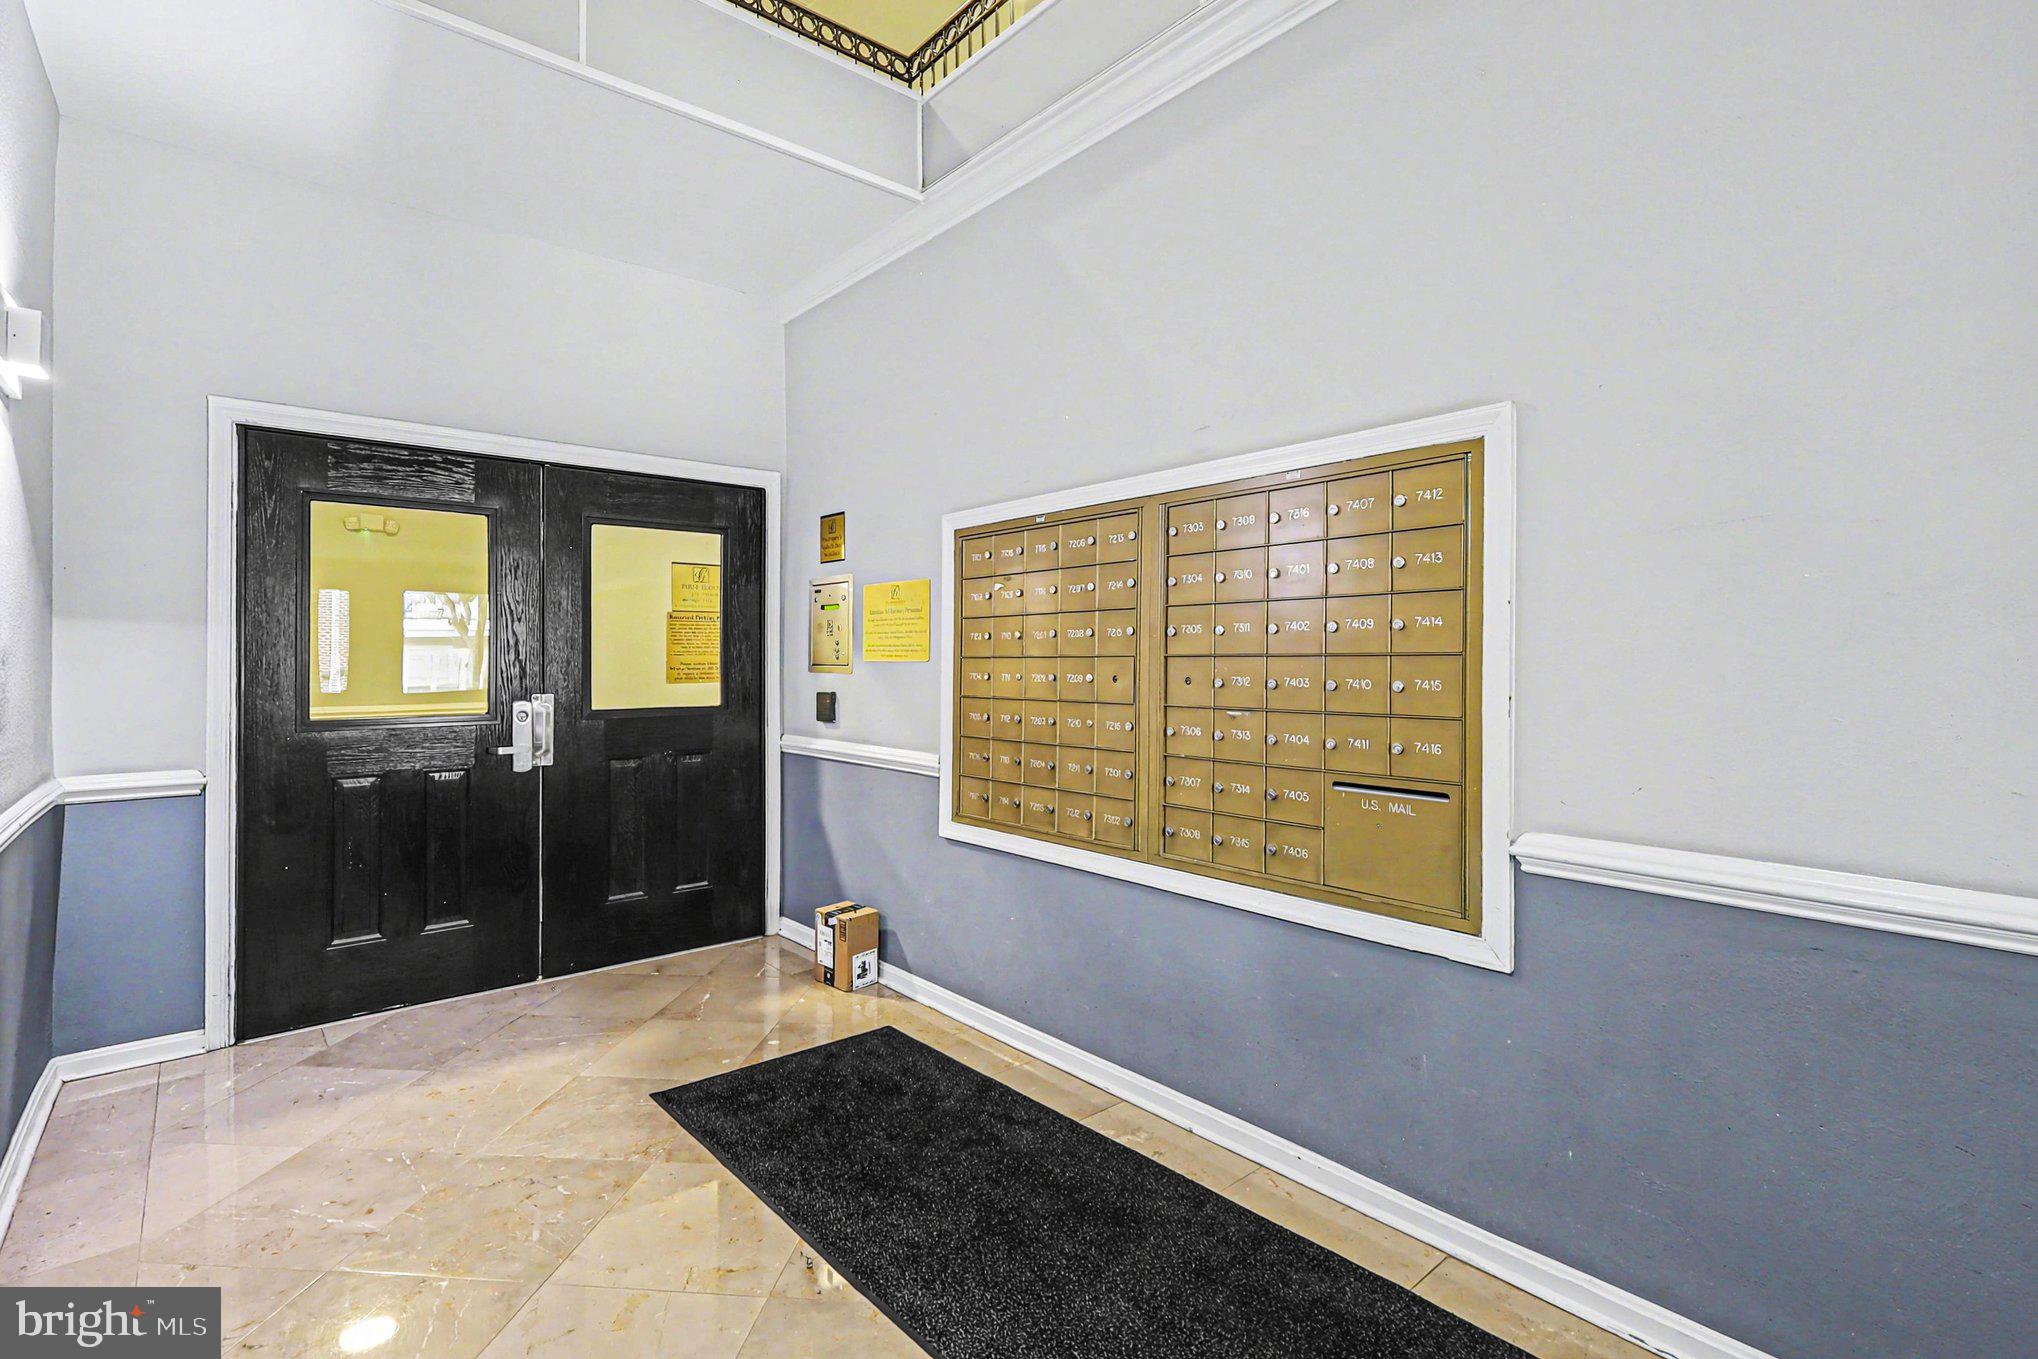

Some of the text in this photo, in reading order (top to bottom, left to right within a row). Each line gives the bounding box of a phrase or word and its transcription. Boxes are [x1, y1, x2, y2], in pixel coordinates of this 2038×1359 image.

[1415, 487, 1444, 502] 7412
[1345, 497, 1375, 512] 7407
[1287, 507, 1310, 521] 7316
[1182, 521, 1204, 533] 7303
[1344, 557, 1375, 571] 7408
[1415, 551, 1443, 565] 7413
[1233, 568, 1253, 580] 7310
[1285, 563, 1310, 576] 7401
[1182, 573, 1203, 584] 7304
[1233, 622, 1251, 633] 7311
[1284, 620, 1310, 631] 7402
[1344, 618, 1375, 630] 7409
[1414, 616, 1443, 628] 7414
[1231, 676, 1251, 687] 7312
[1283, 676, 1310, 688] 7403
[1345, 678, 1372, 690] 7410
[1414, 679, 1442, 692] 7415
[1231, 729, 1252, 741] 7313
[1283, 733, 1310, 745] 7404
[1347, 737, 1370, 750] 7411
[1413, 741, 1442, 756] 7416
[1180, 776, 1202, 788] 7307
[1230, 782, 1251, 794] 7314
[1283, 789, 1310, 802] 7405
[1361, 798, 1417, 817] U.S. MAIL
[1282, 844, 1309, 860] 7406
